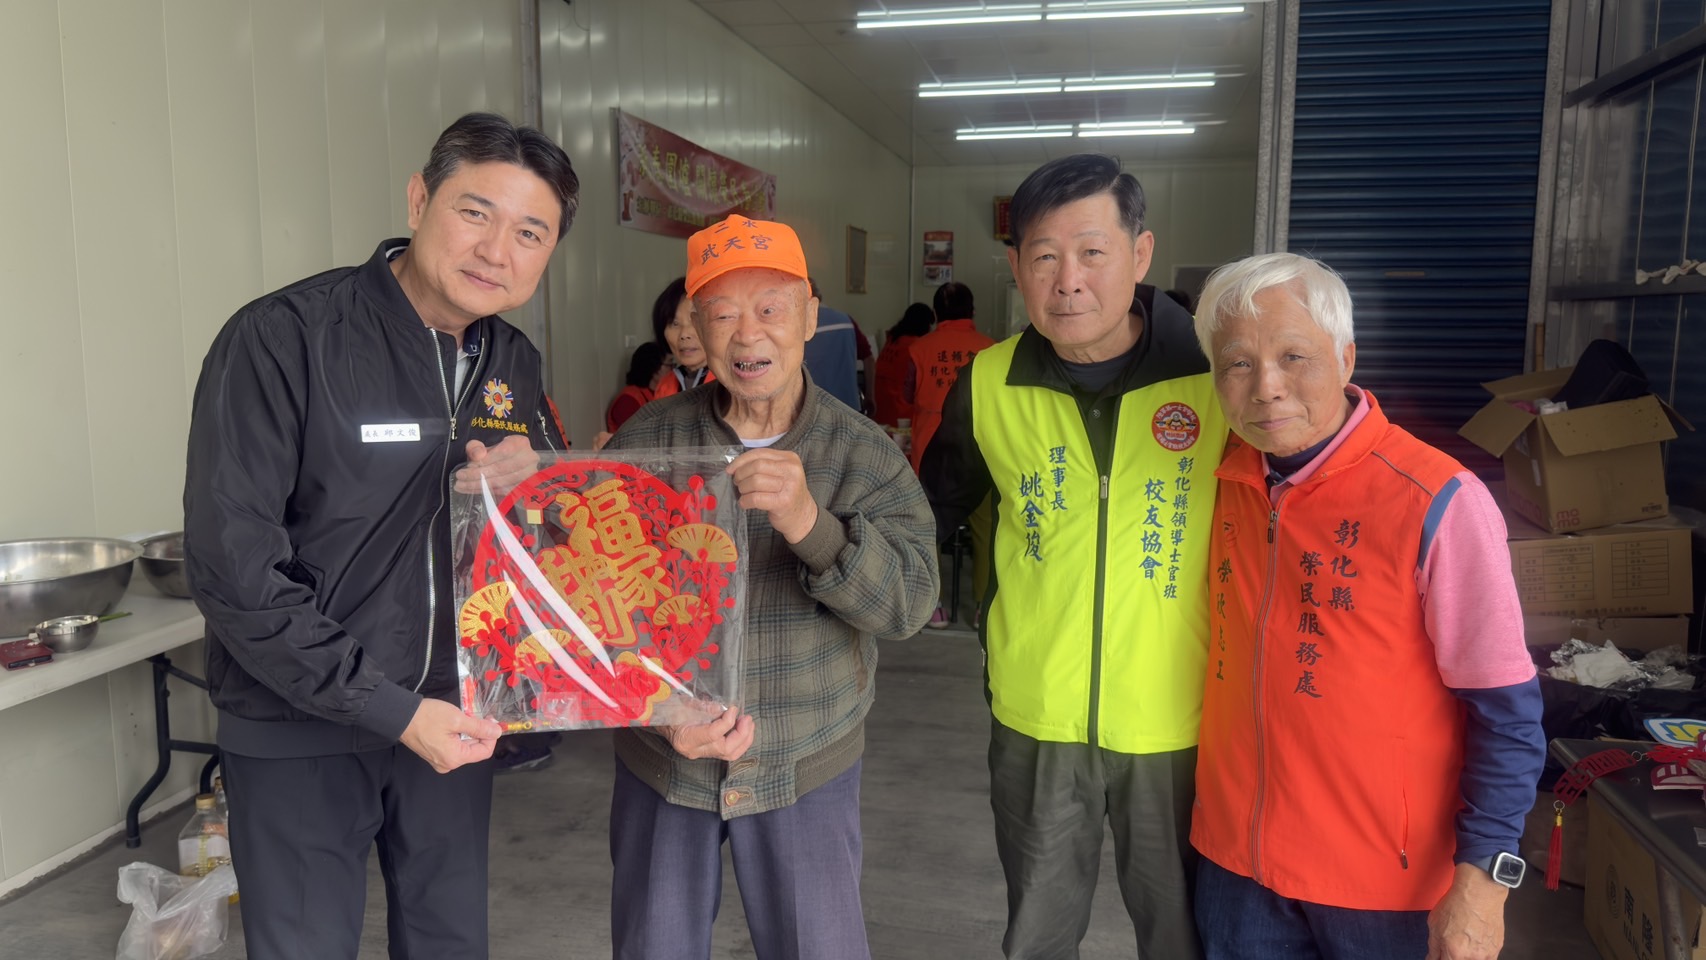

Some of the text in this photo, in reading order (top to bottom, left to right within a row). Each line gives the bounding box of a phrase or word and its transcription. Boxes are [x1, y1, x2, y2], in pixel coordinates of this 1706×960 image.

[701, 235, 773, 265] 武天宮
[714, 220, 758, 234] 二水
[1019, 471, 1045, 562] 姚金俊
[1049, 446, 1068, 512] 理事長
[1138, 478, 1168, 580] 校友協會
[1163, 456, 1195, 599] 彰化縣領導士官班
[1327, 519, 1361, 612] 彰化縣
[1293, 551, 1325, 699] 榮民服務處
